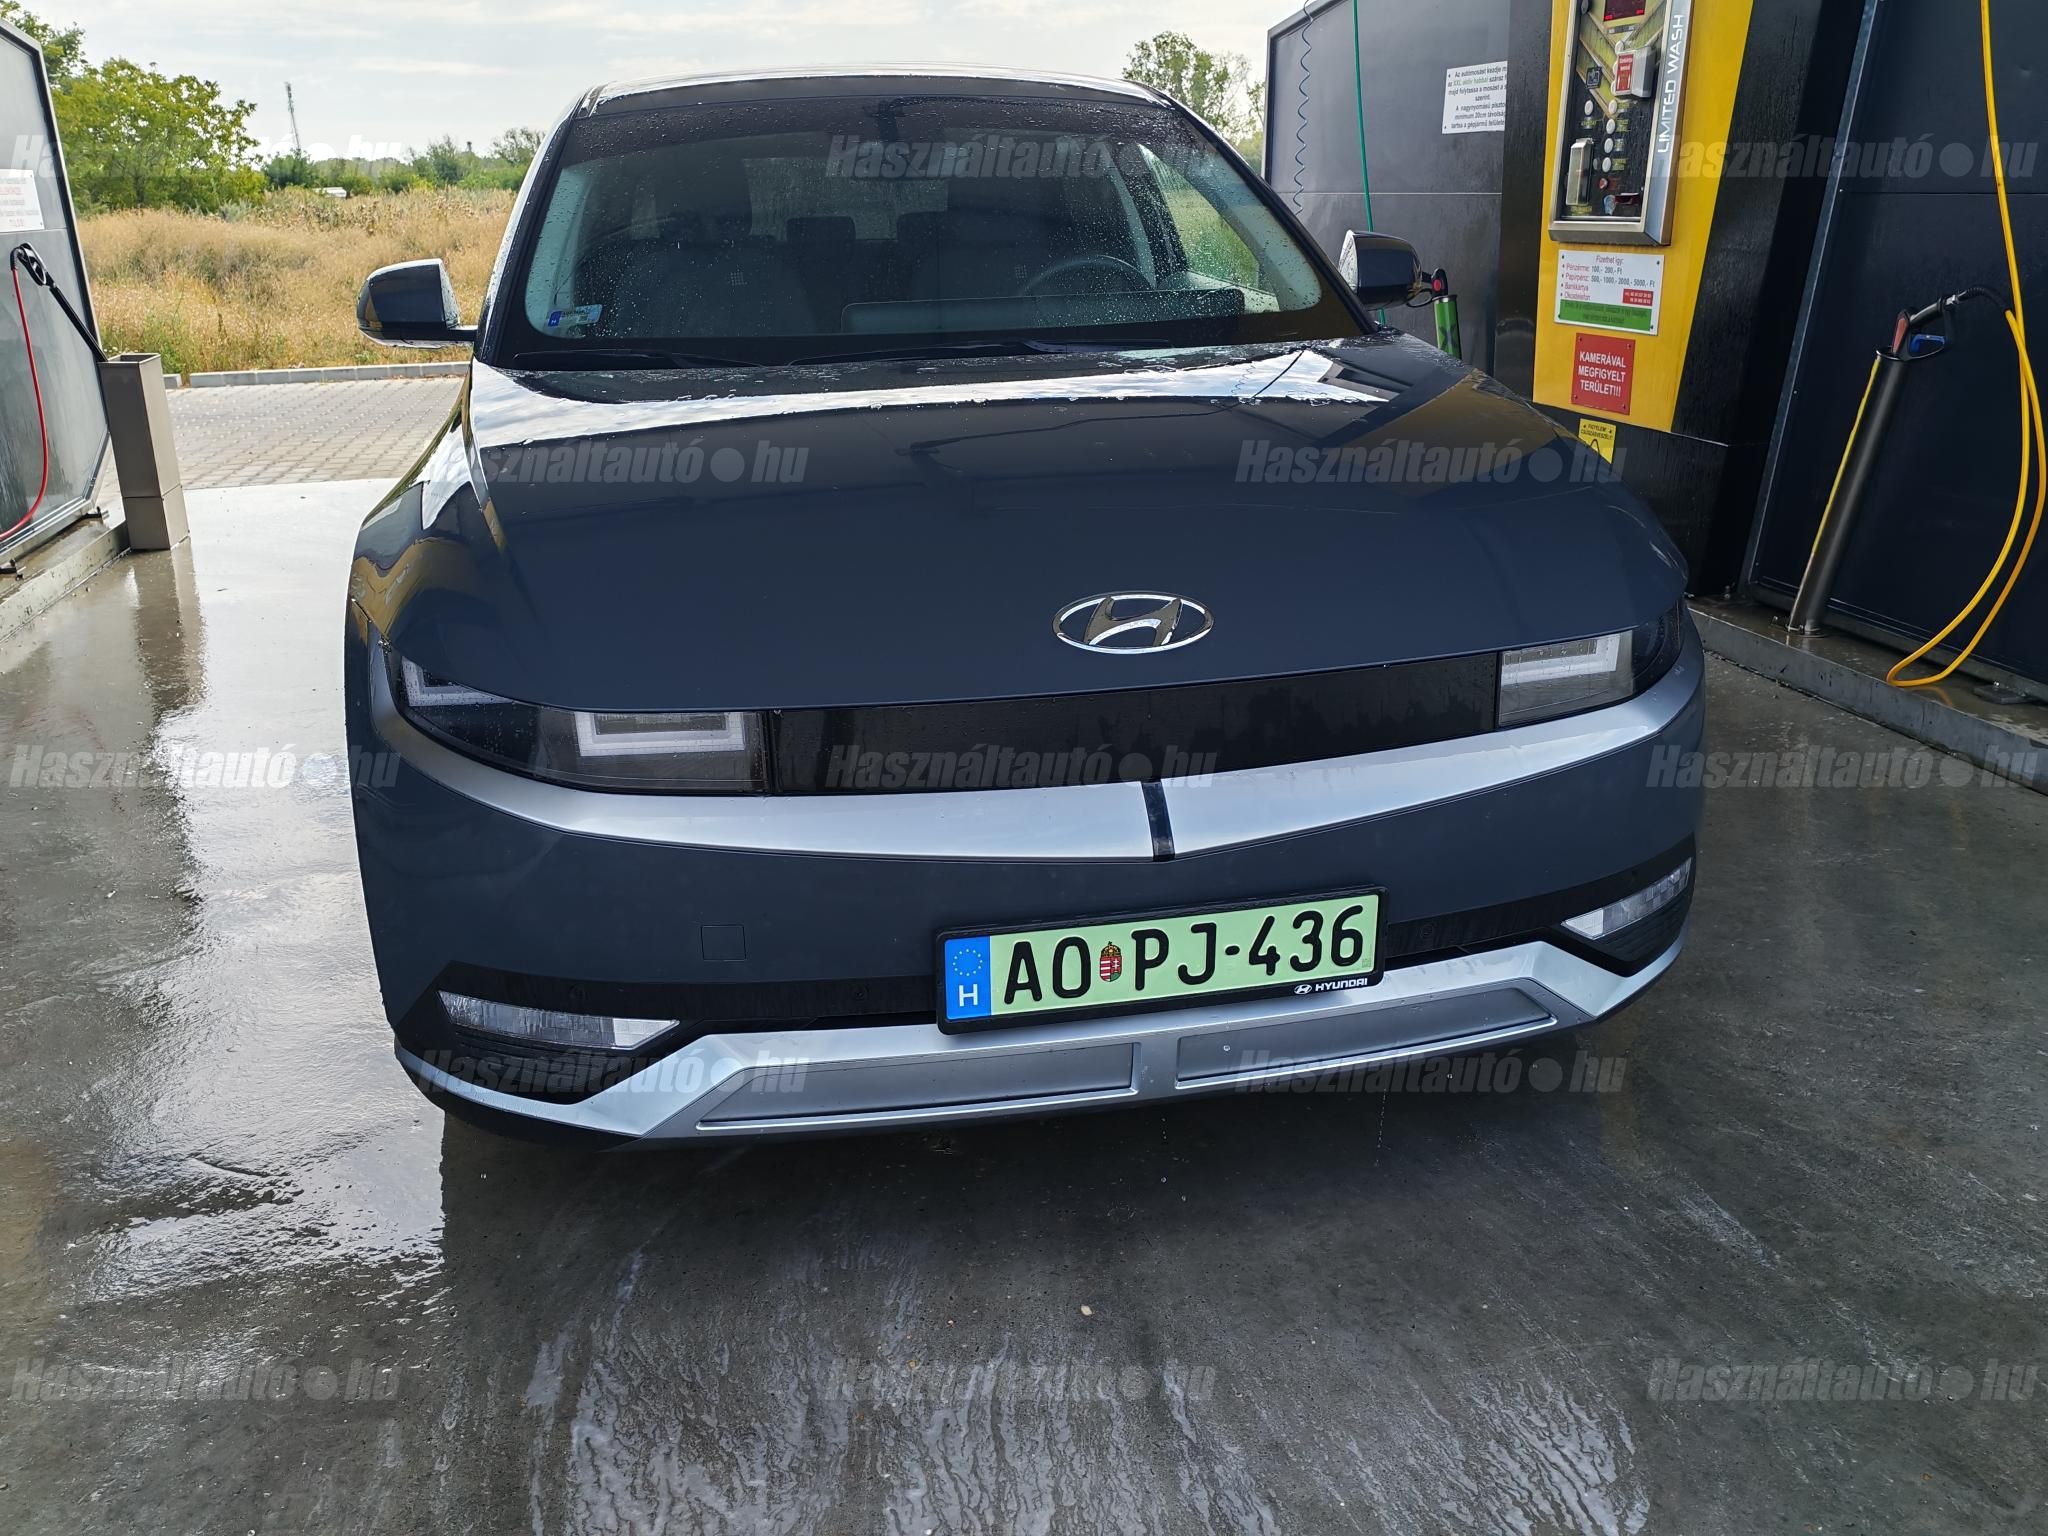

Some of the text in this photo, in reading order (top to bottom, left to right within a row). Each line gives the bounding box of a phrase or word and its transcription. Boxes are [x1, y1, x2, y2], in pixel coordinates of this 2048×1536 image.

[1658, 15, 1685, 153] LIMITED WASH
[1579, 351, 1627, 368] KAMERÁVAL
[1578, 366, 1626, 383] MEGFIGYELT
[1580, 379, 1621, 397] TERÜLET!!!
[1130, 904, 1365, 991] PJ-436
[1315, 978, 1368, 992] HYUNDAI
[958, 983, 979, 1008] H
